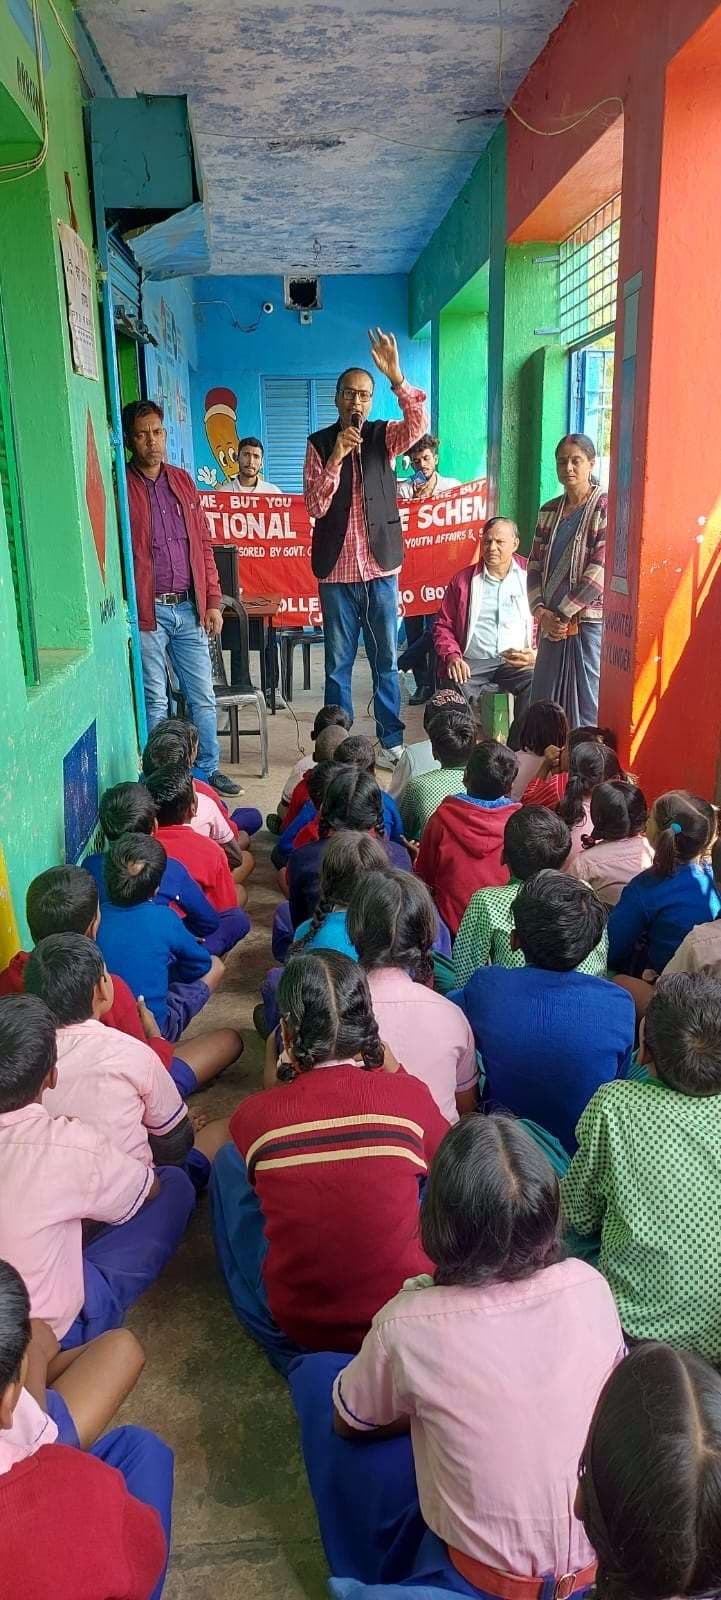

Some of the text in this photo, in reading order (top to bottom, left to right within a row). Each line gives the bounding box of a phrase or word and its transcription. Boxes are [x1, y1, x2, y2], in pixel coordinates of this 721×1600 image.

[230, 496, 260, 509] BUT
[265, 497, 292, 508] YOU
[270, 546, 281, 557] BY
[283, 546, 306, 557] GOVT.
[405, 537, 433, 548] YOUTH
[435, 530, 466, 544] AFFAIRS
[468, 531, 477, 541] &
